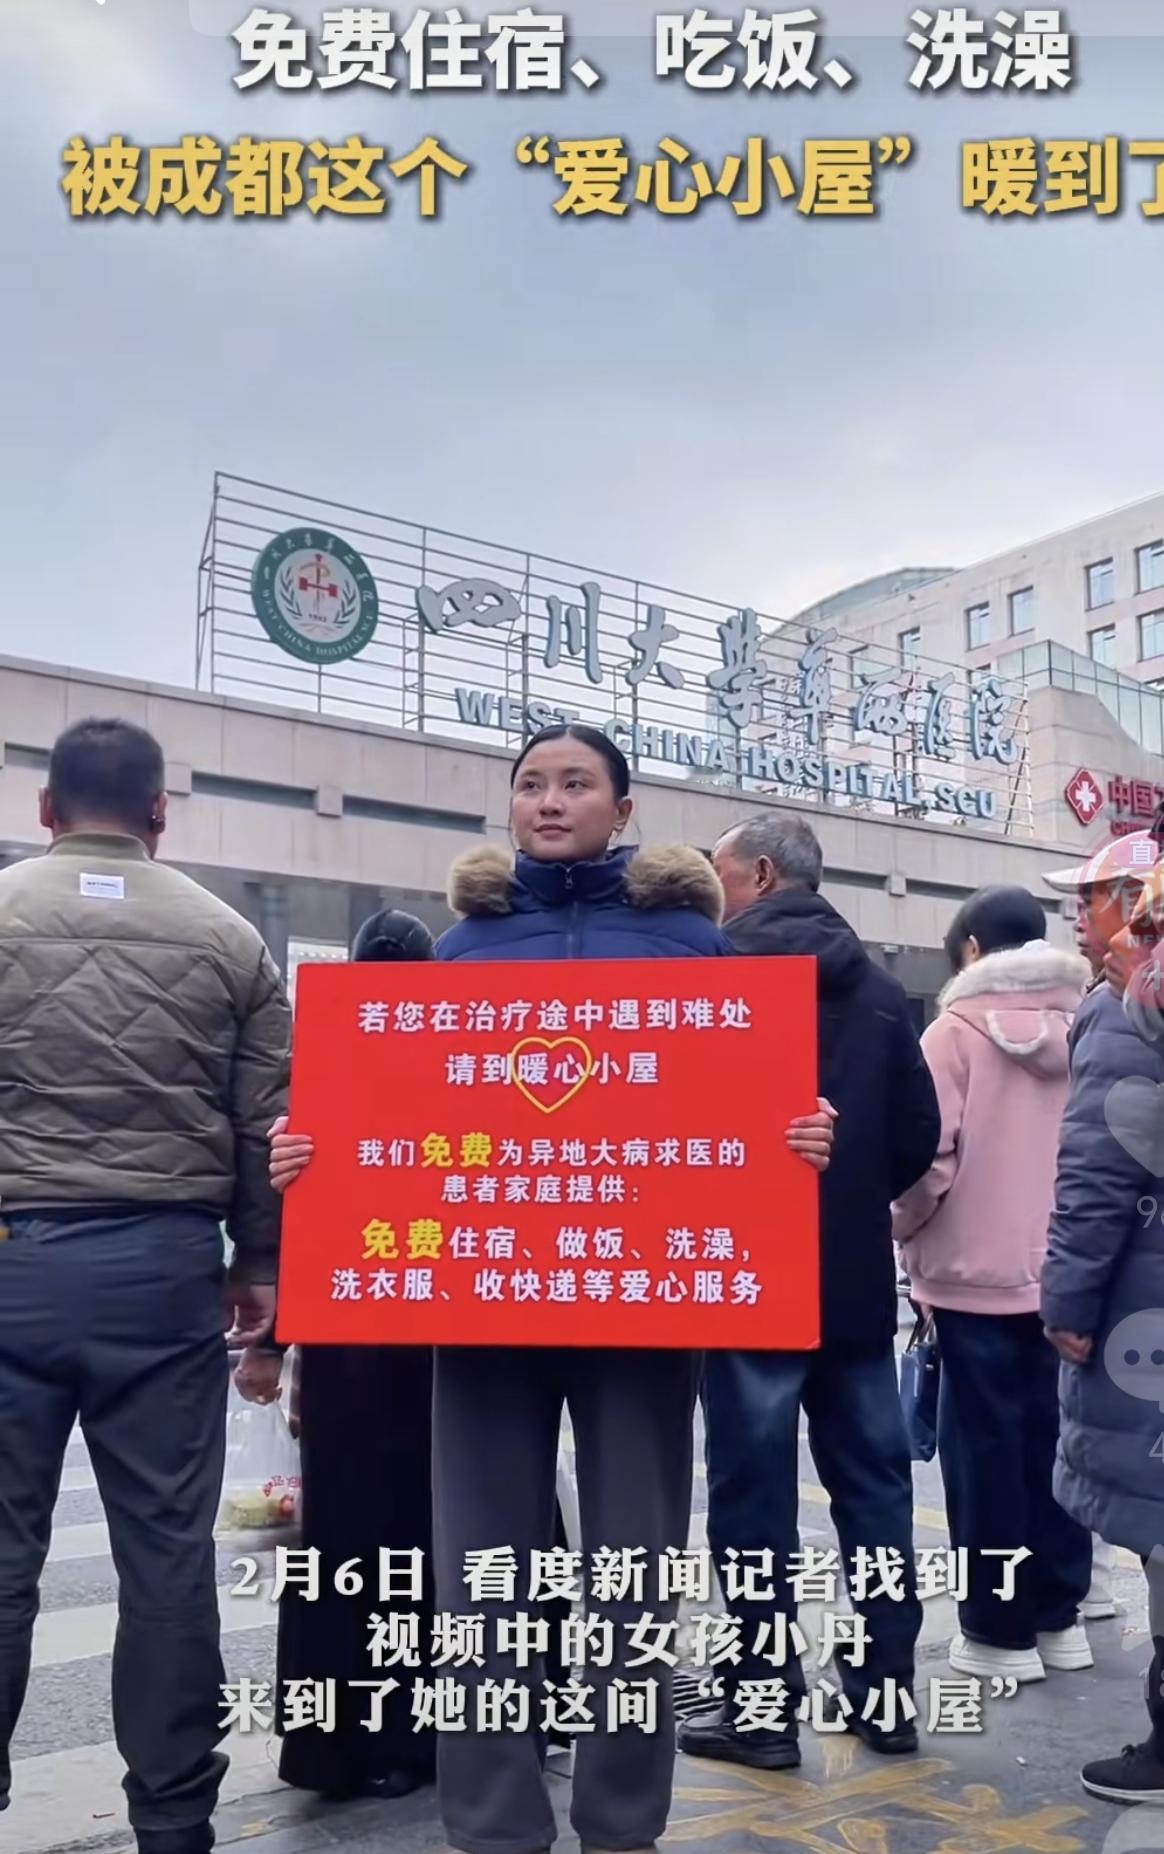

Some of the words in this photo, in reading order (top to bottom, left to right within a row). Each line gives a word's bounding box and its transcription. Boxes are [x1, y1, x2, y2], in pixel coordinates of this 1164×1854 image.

[454, 687, 580, 740] WEST
[604, 717, 735, 773] CHINA
[748, 746, 922, 806] HOSPITAL
[934, 780, 997, 819] SCU
[357, 998, 753, 1033] 若您在治疗途中遇到难处
[445, 1051, 660, 1086] 请到暖心小屋
[357, 1131, 746, 1170] 我们免费为异地大病求医的
[330, 1267, 763, 1305] 洗衣服、收快递等爱心服务
